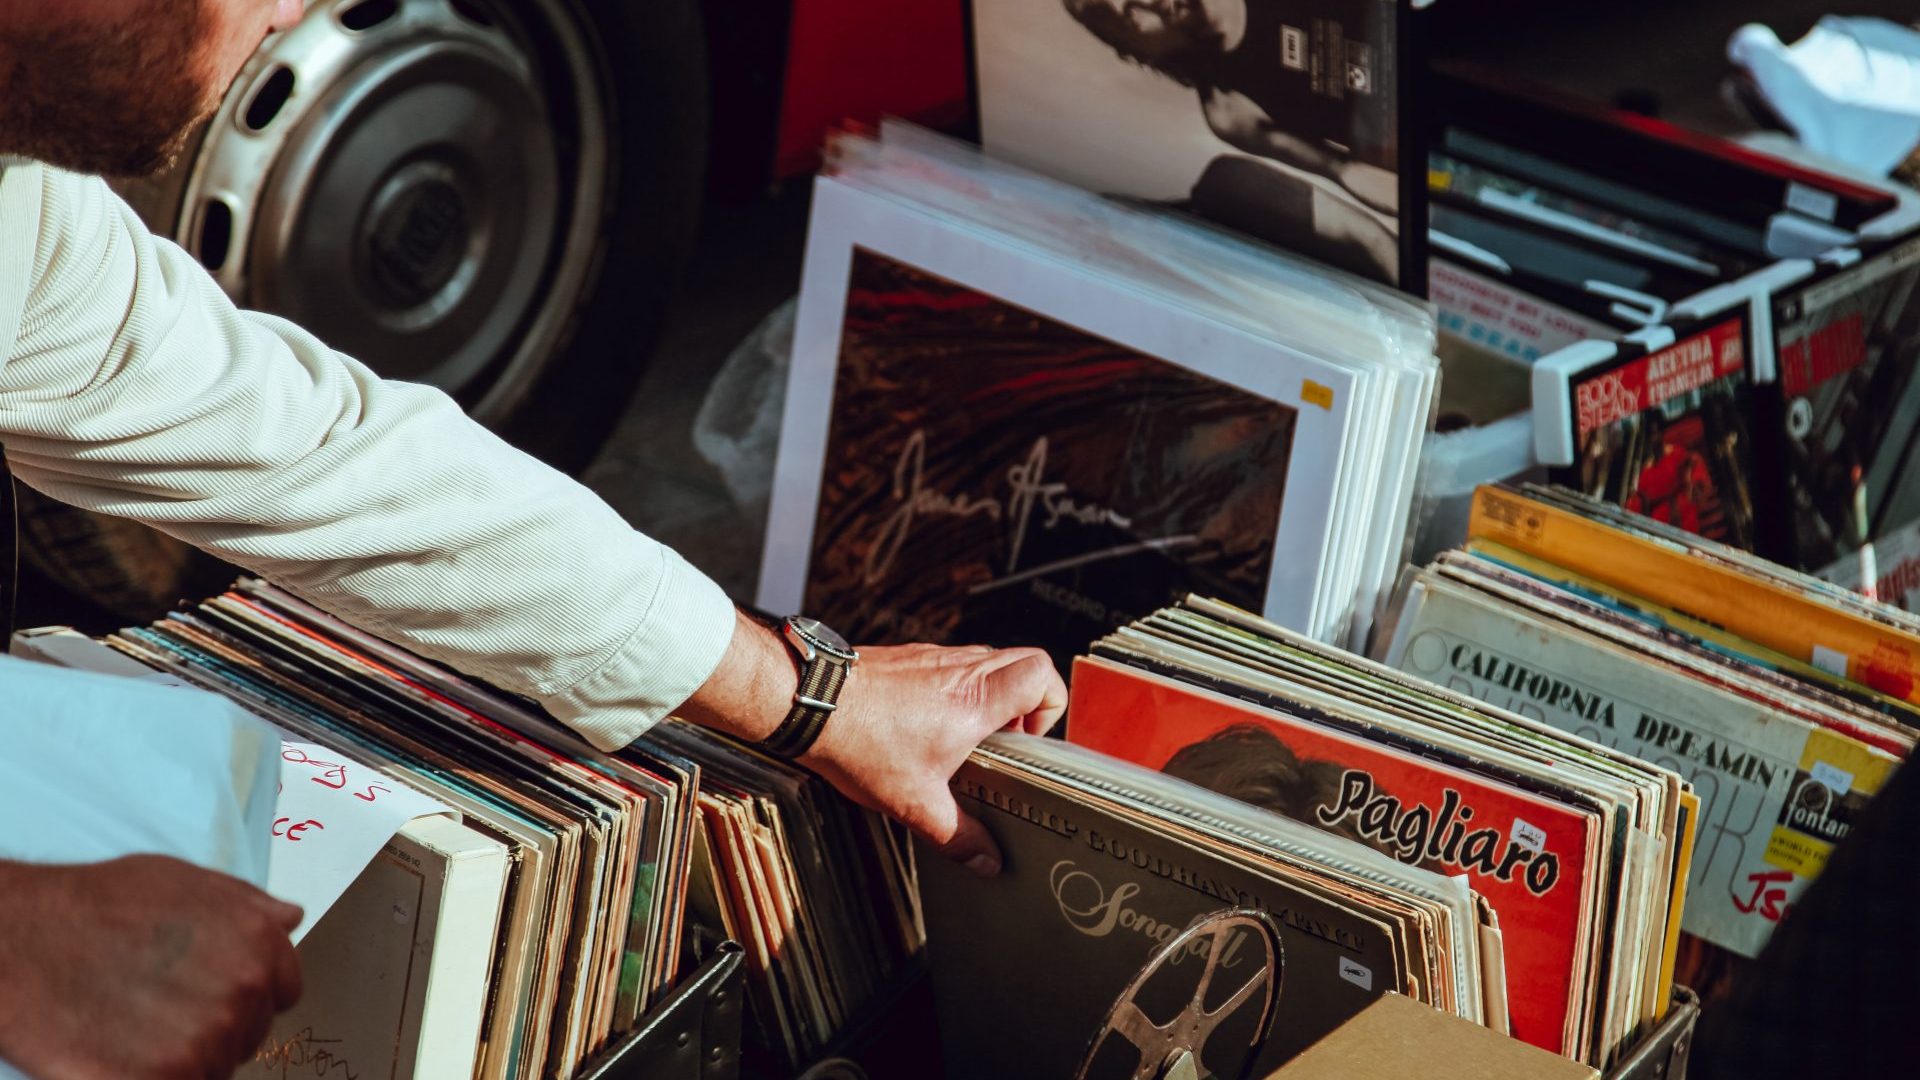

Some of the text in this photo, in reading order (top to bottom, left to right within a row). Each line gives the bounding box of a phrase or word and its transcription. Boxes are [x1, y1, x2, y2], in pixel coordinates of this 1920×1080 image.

[1451, 643, 1615, 729] CALIFORNIA
[1317, 769, 1561, 897] Pagliaro
[1785, 786, 1852, 838] fontan
